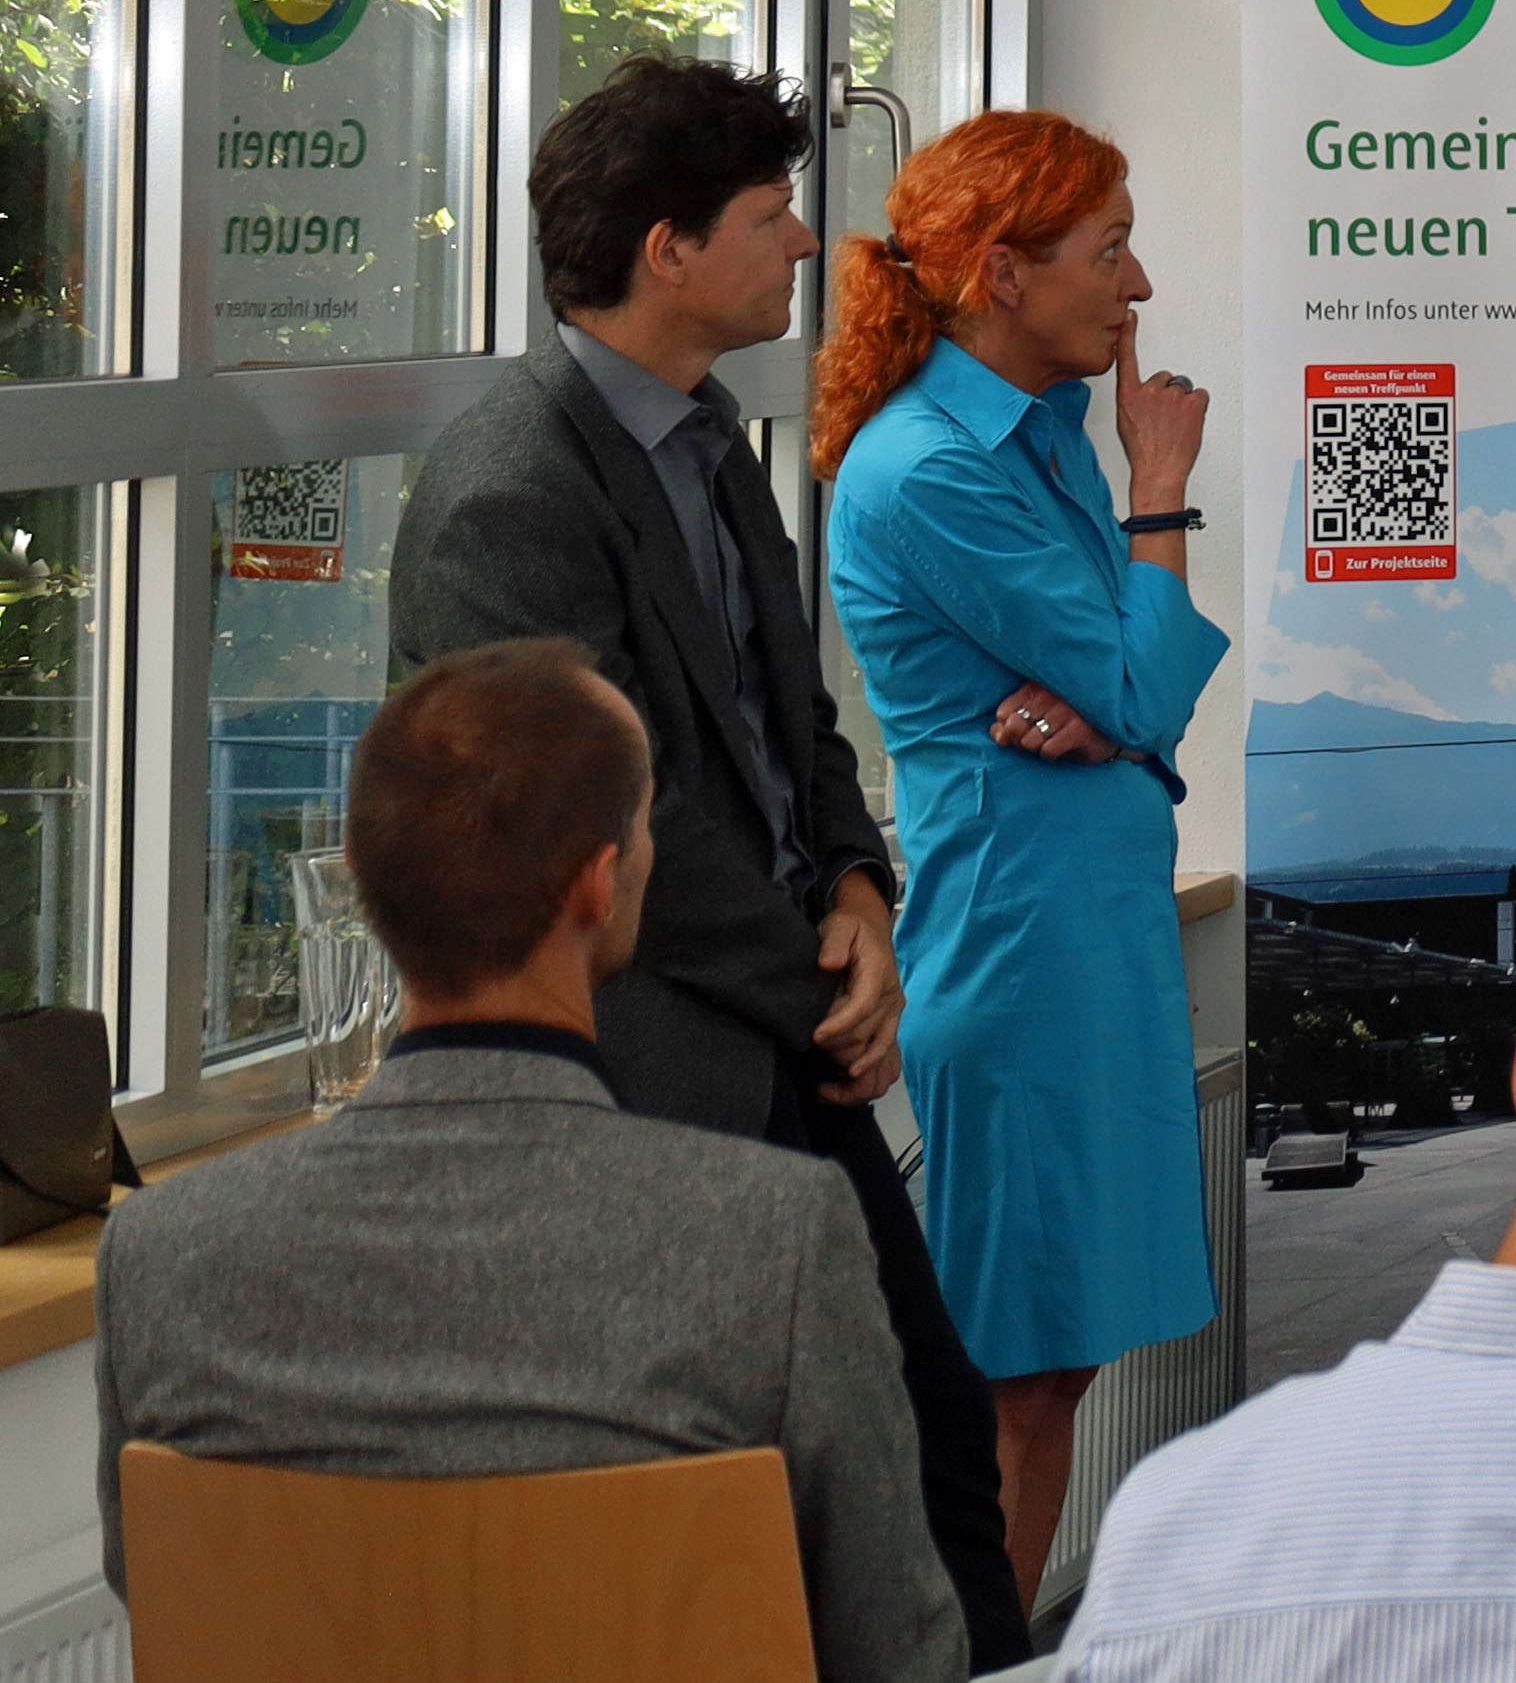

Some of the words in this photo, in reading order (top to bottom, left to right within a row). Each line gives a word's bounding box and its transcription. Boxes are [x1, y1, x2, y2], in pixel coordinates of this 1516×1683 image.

[1306, 215, 1489, 256] neuen
[1304, 301, 1359, 320] Mehr
[1364, 298, 1418, 320] Infos
[1423, 302, 1480, 320] unter
[1323, 370, 1387, 381] Gemeinsam
[1388, 369, 1406, 381] für
[1406, 370, 1437, 381] einen
[1334, 384, 1369, 394] neuen
[1370, 382, 1427, 396] Treffpunkt
[1345, 557, 1369, 570] Zur
[1370, 556, 1449, 572] Projektseite
